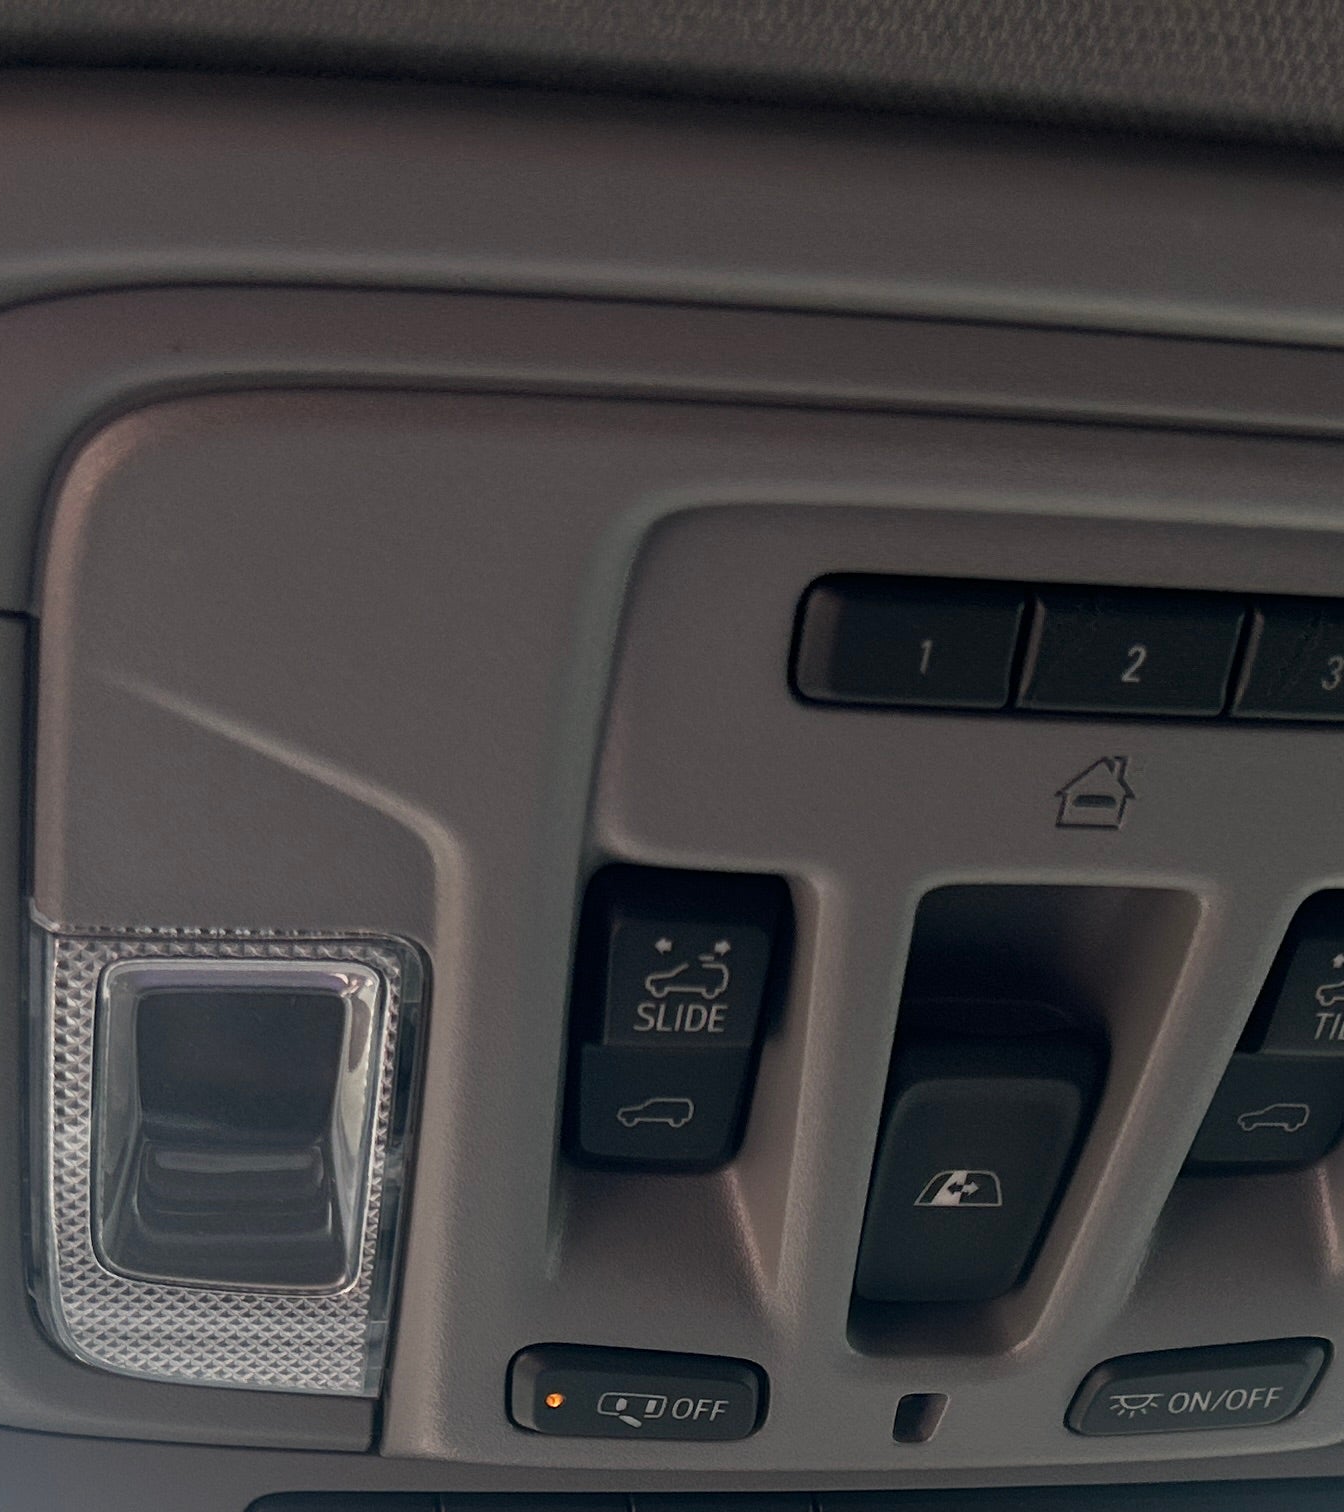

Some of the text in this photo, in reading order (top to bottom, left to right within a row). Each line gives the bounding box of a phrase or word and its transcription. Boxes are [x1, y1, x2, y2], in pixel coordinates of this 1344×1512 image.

[918, 639, 933, 676] 1
[1121, 645, 1148, 684] 2
[632, 1002, 729, 1034] SLIDE
[670, 1396, 731, 1423] OFF
[1167, 1385, 1282, 1417] ON/OFF
